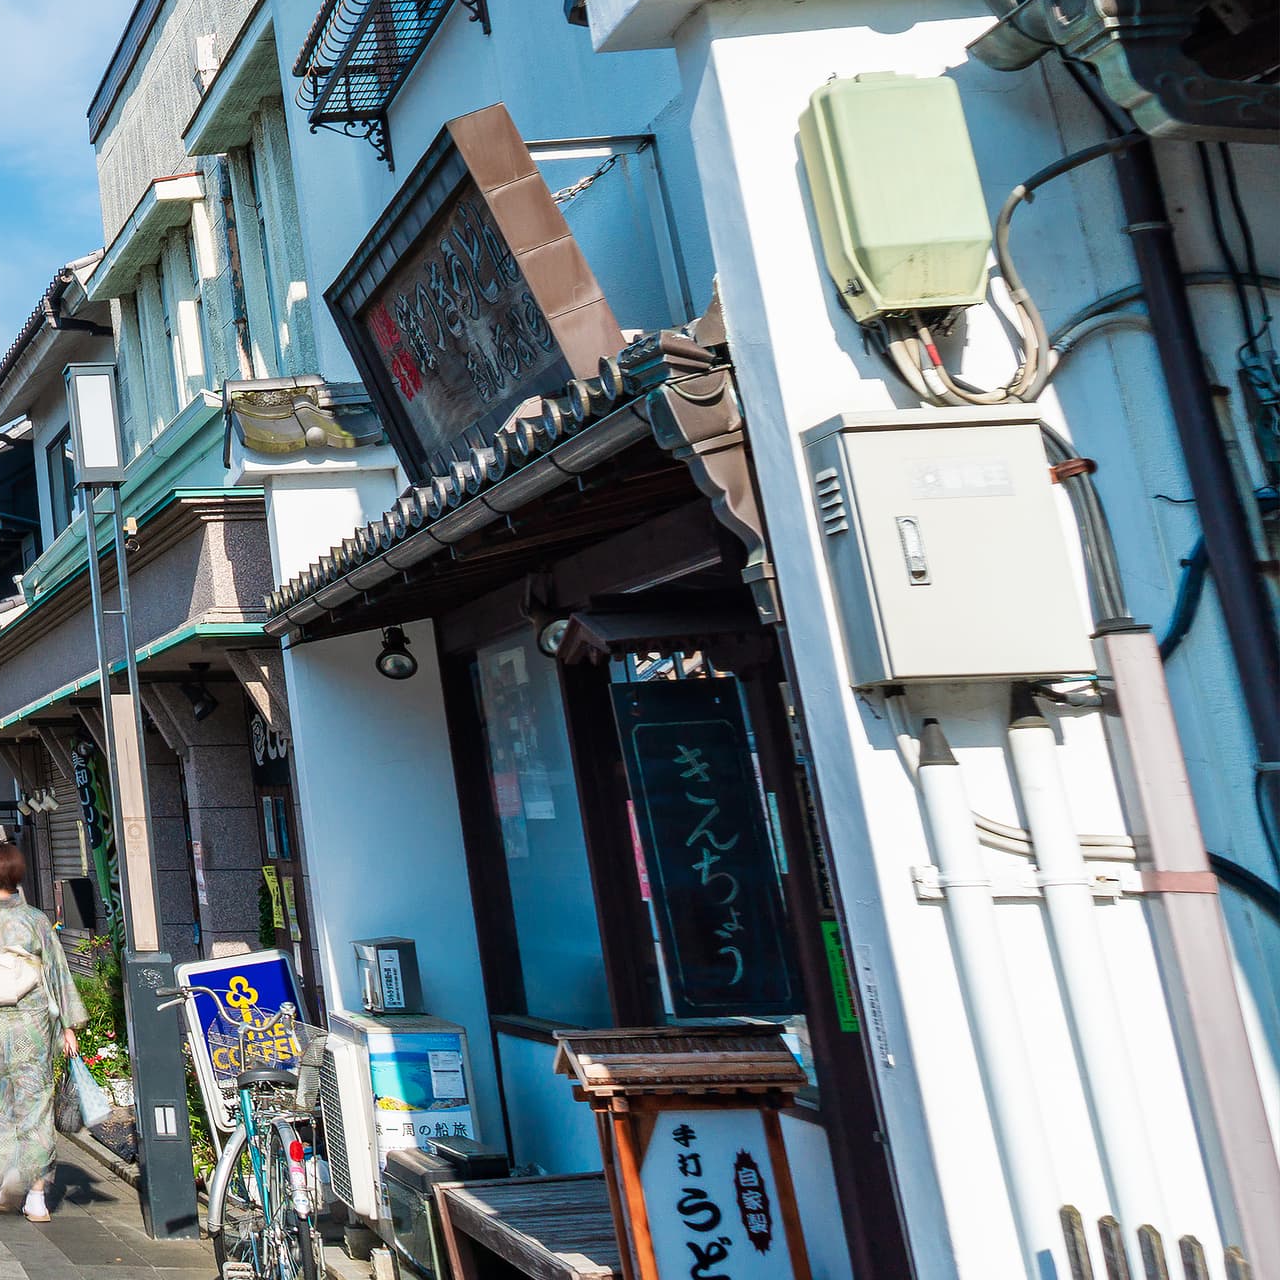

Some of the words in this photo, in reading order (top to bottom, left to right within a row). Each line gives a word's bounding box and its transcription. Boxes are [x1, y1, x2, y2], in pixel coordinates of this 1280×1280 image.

[672, 744, 745, 986] きんちょう
